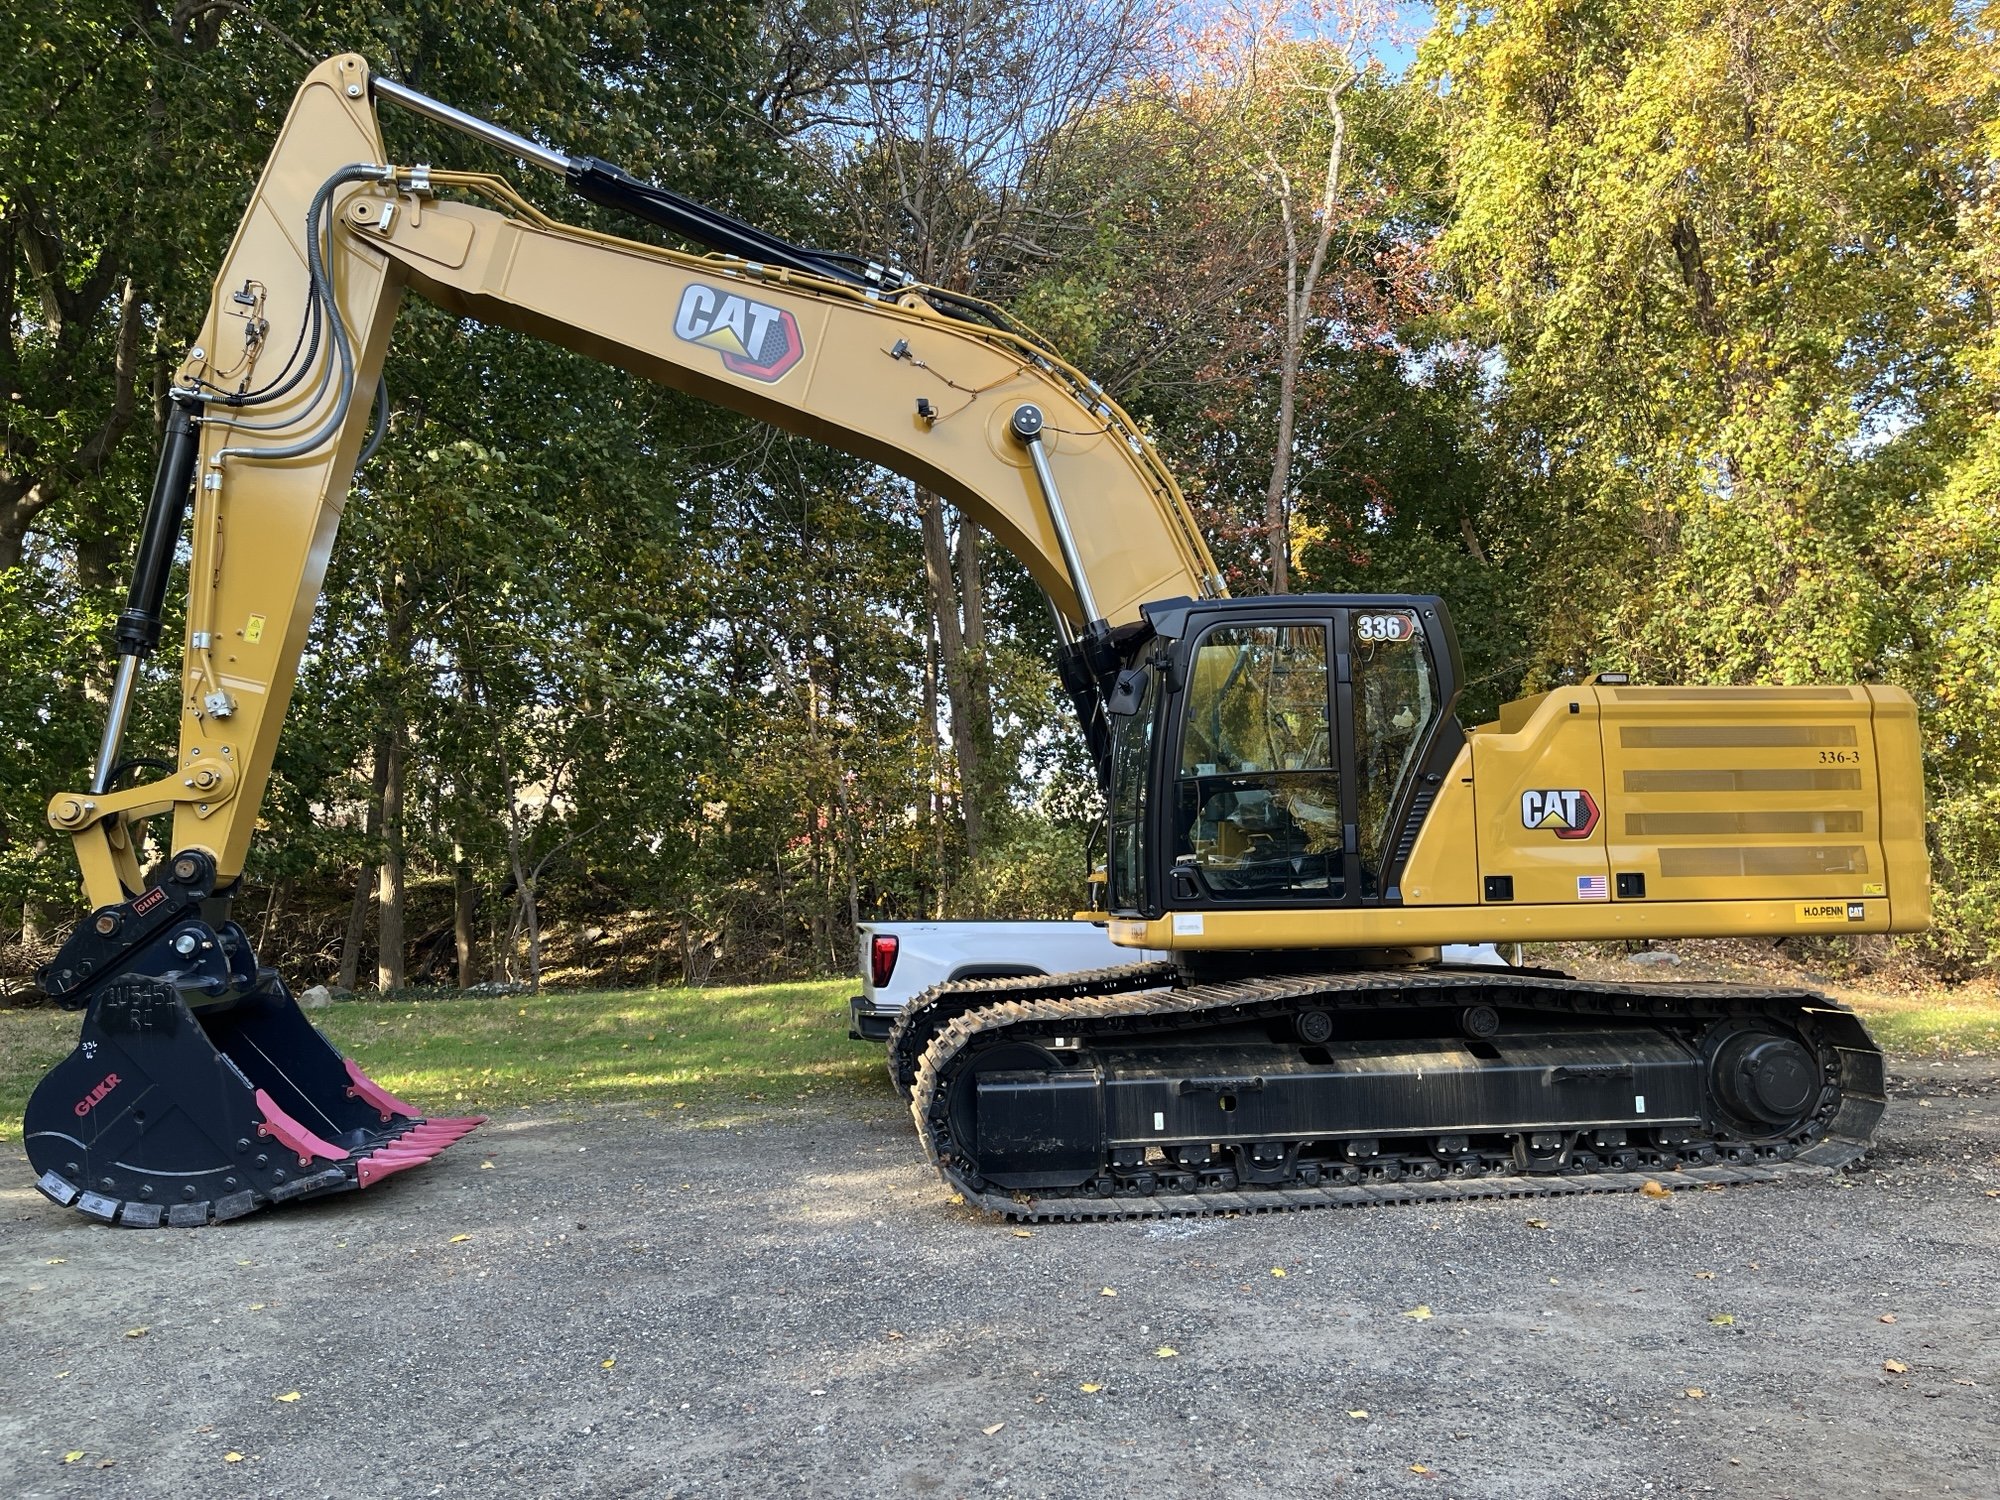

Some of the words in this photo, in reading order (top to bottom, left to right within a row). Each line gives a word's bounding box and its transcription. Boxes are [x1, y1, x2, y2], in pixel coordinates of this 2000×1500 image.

[675, 285, 780, 360] CAT
[1359, 616, 1400, 639] 336
[1818, 751, 1860, 764] 336-3
[1522, 791, 1580, 828] CAT
[137, 892, 162, 912] GLIKR
[1848, 906, 1863, 917] CAT
[82, 1040, 98, 1050] 336
[74, 1073, 122, 1116] GLIKR
